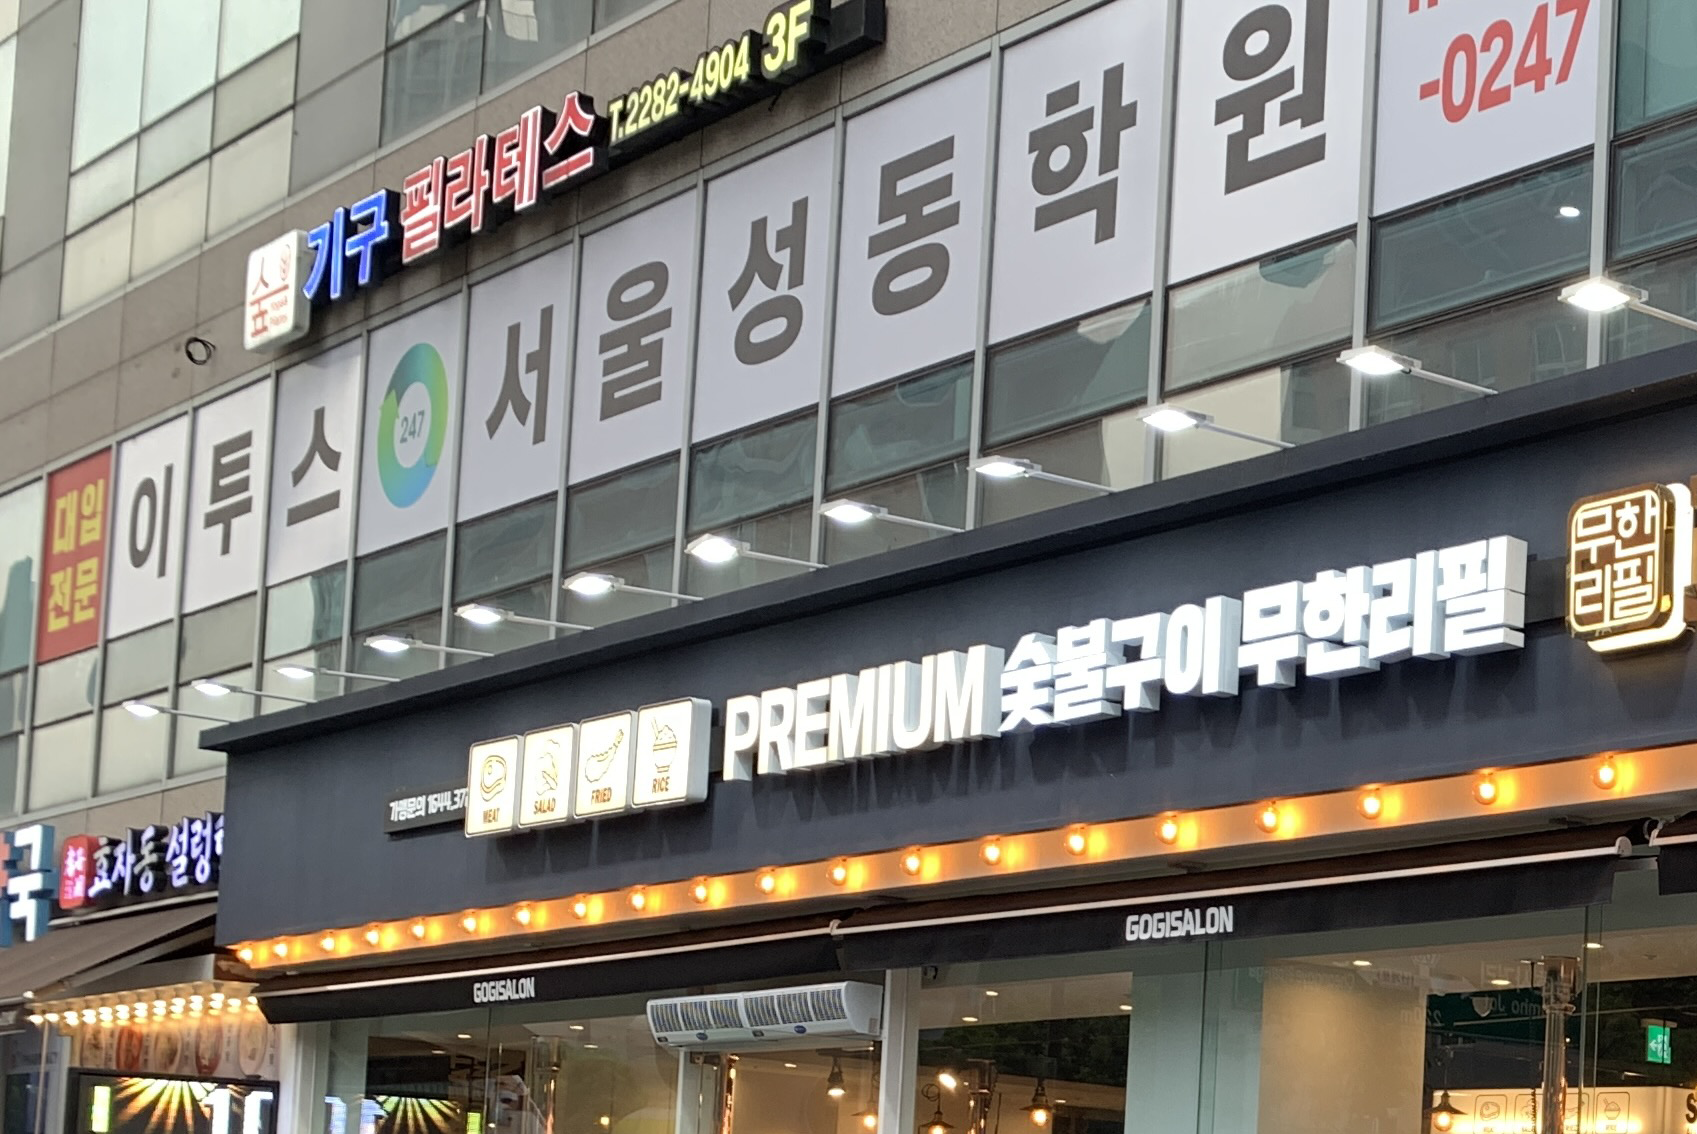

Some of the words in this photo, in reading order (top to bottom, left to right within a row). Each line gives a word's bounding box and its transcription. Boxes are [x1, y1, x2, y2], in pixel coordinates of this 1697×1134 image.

[609, 32, 751, 145] T.2282-4904
[761, 1, 812, 75] 3F
[1419, 0, 1590, 125] -0247
[303, 188, 391, 302] 기구
[402, 90, 595, 265] 필라테스
[399, 410, 427, 443] 247
[51, 479, 106, 556] 대입
[129, 407, 342, 578] 이투스
[1573, 497, 1661, 556] 무한
[48, 565, 102, 634] 전문
[1573, 554, 1661, 632] 리필
[724, 646, 1003, 782] PREMIUM
[1000, 596, 1240, 734] 숯불구이
[1241, 535, 1529, 691] 무한리필
[483, 808, 500, 824] MEAT
[533, 797, 556, 815] SALAD
[590, 787, 612, 804] FRIED
[652, 776, 670, 794] RICE
[88, 824, 159, 898] 효자동
[1125, 905, 1234, 942] GOGISALON
[473, 977, 535, 1004] GOGISALON
